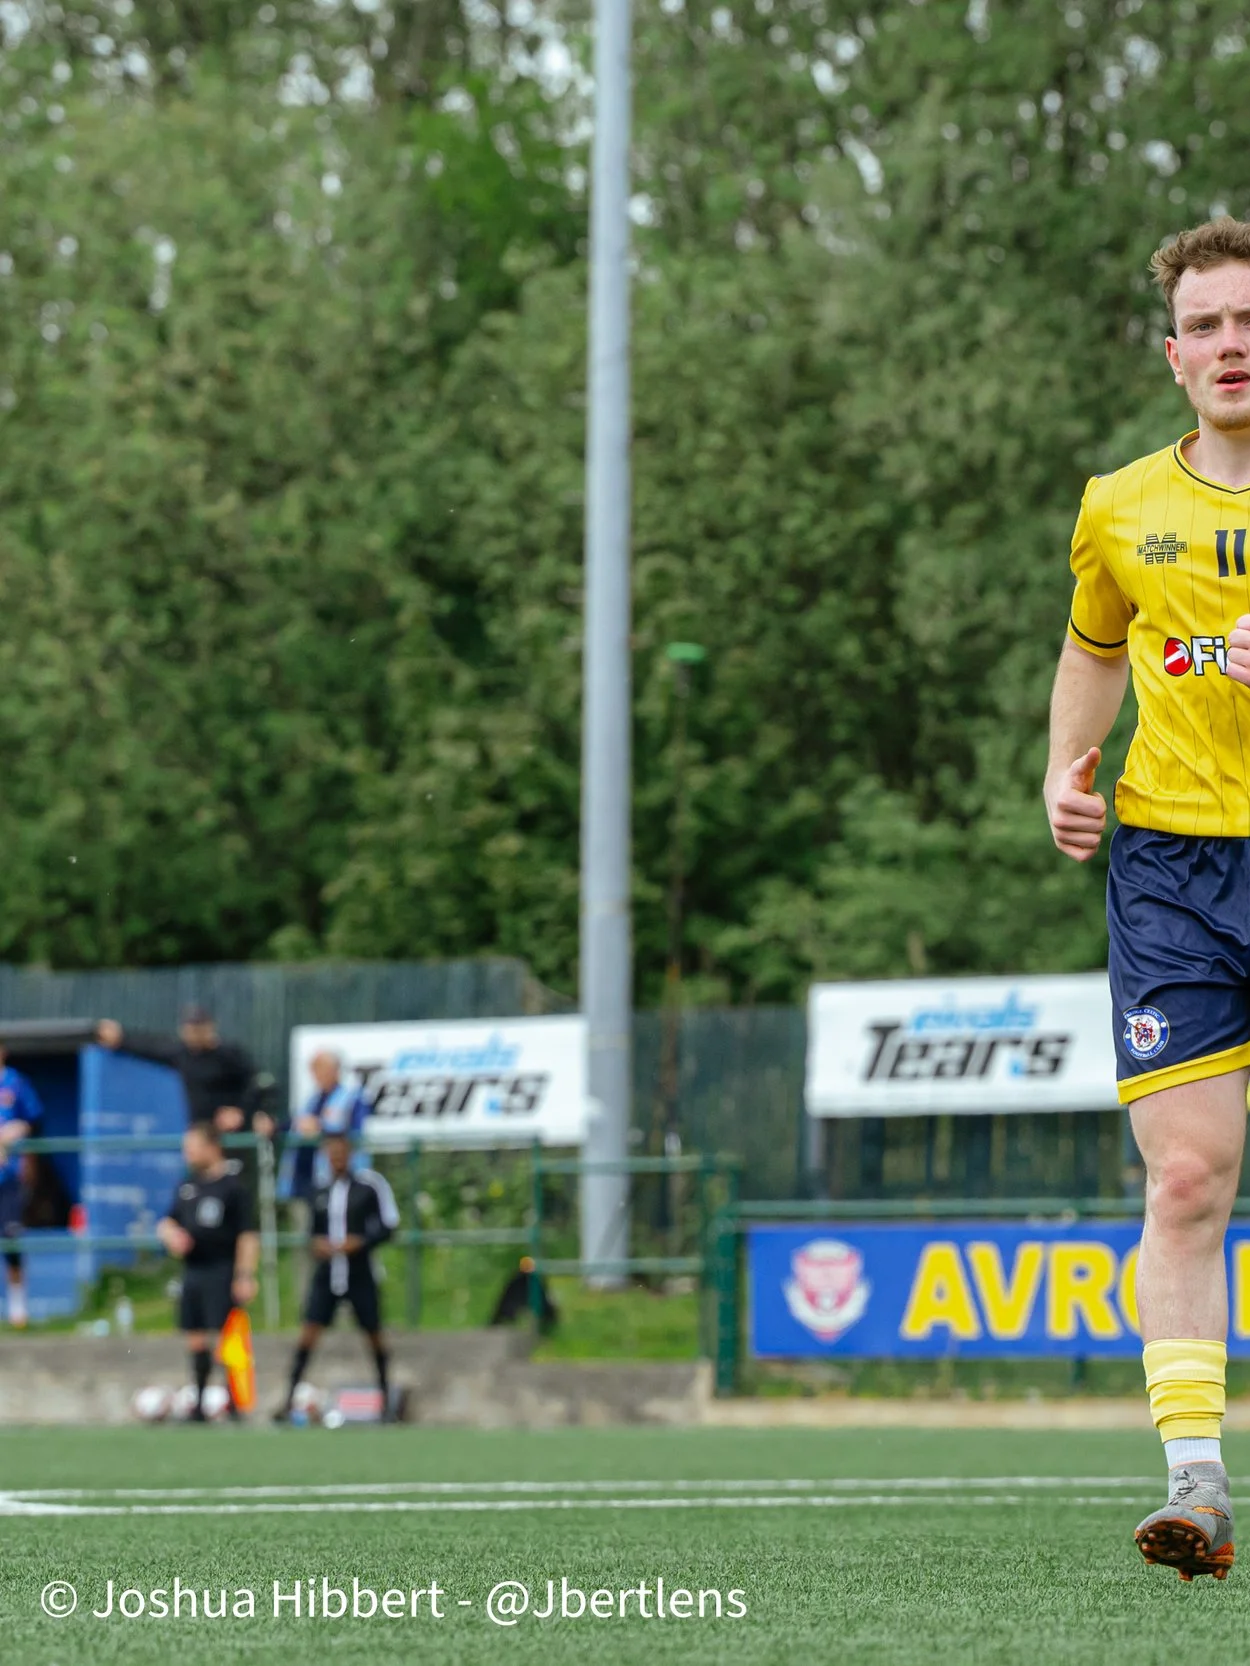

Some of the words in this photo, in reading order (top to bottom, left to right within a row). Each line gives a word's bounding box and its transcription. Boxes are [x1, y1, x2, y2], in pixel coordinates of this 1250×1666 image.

[1138, 542, 1185, 554] MATCHWINNER
[1215, 529, 1247, 578] 11
[863, 1016, 1074, 1081] Tears
[350, 1058, 552, 1121] Tears
